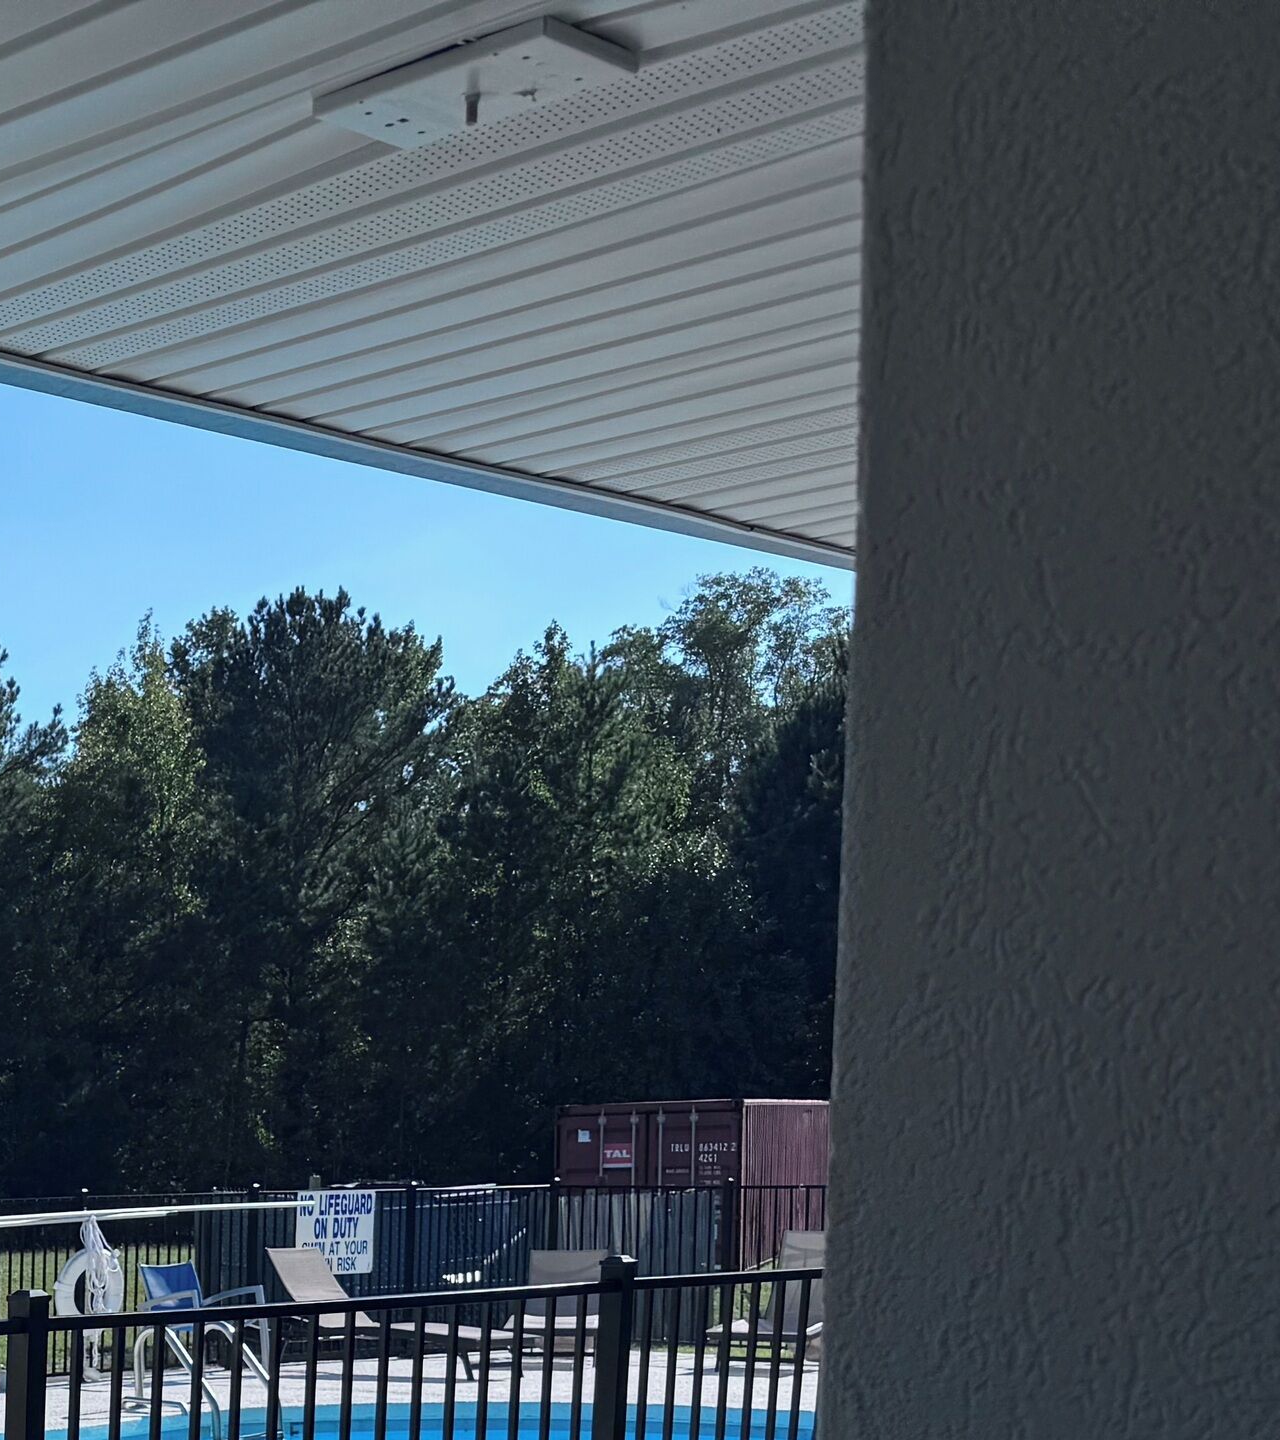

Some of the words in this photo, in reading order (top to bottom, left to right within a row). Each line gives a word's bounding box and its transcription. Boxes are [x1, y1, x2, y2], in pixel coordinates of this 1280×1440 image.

[604, 1149, 631, 1158] TAL
[300, 1194, 315, 1217] NO
[319, 1193, 373, 1216] LIFEGUARD
[314, 1217, 328, 1240] ON
[332, 1216, 359, 1239] DUTY
[328, 1241, 341, 1256] AT
[344, 1240, 368, 1255] YOUR
[336, 1256, 357, 1272] RISK
